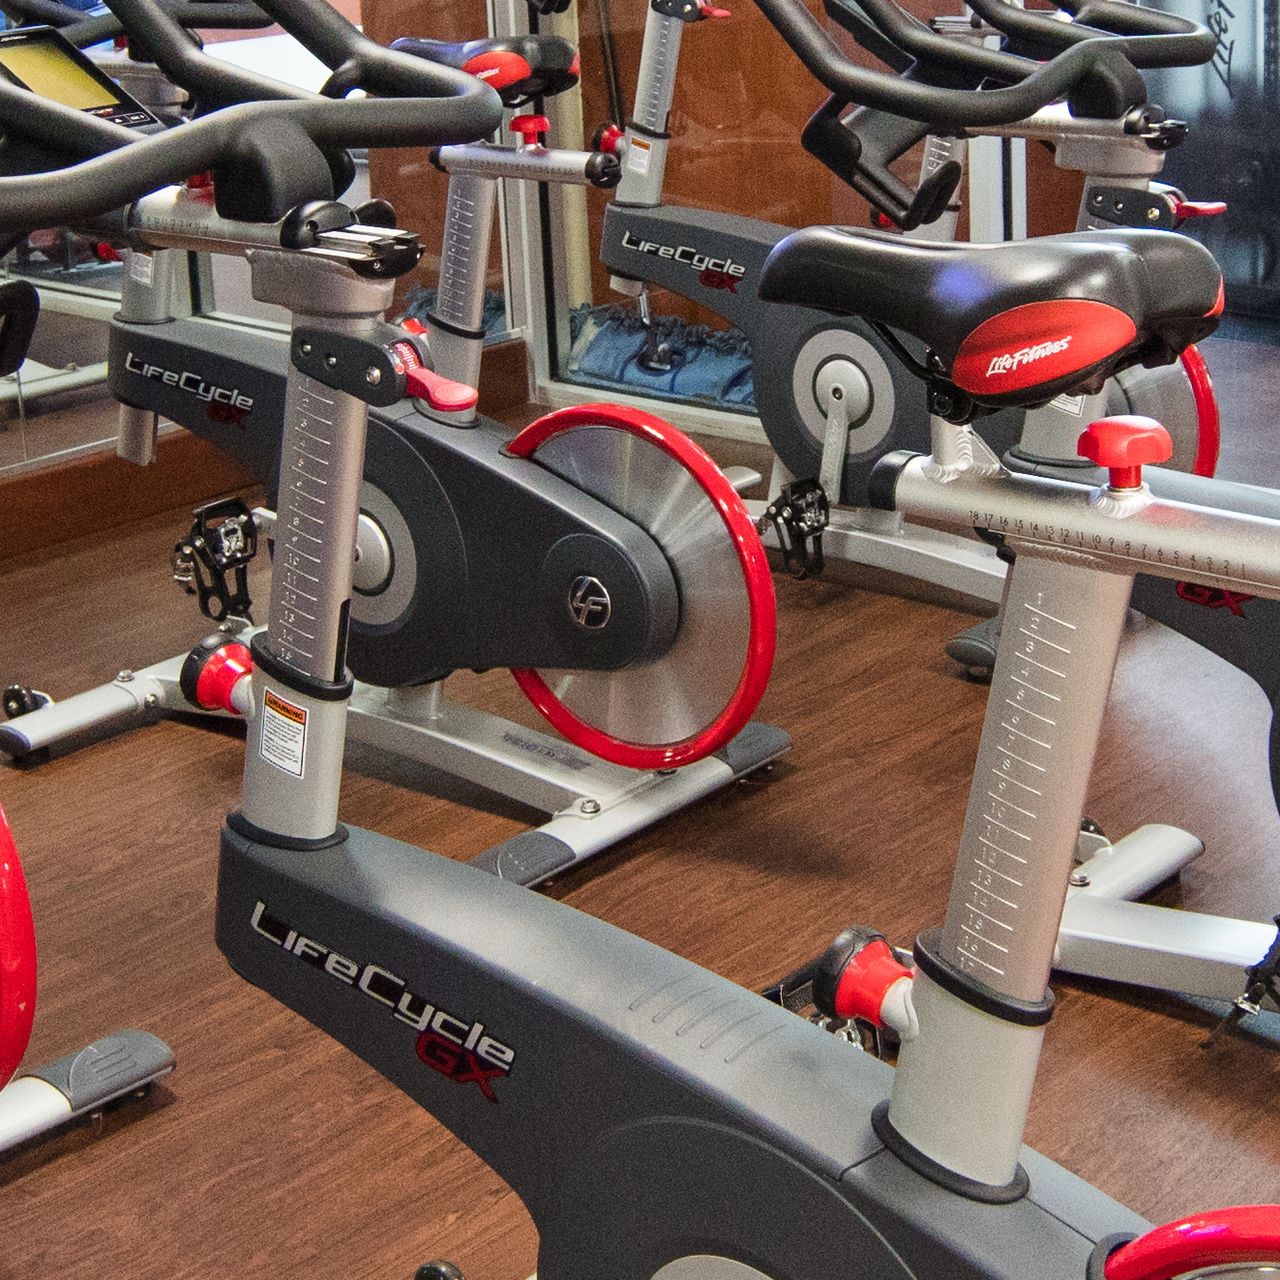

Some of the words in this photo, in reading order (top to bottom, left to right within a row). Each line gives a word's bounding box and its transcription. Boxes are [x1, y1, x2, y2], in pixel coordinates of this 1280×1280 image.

[621, 230, 746, 278] LifeCycle
[125, 351, 255, 412] LifeCycle
[970, 510, 979, 520] 18
[984, 513, 993, 522] 17
[999, 516, 1009, 526] 16
[1014, 519, 1024, 529] 15
[1029, 522, 1039, 532] 14
[1044, 525, 1055, 535] 13
[1060, 528, 1069, 538] 12
[1075, 531, 1084, 541] 11
[1091, 534, 1101, 544] 10
[250, 900, 515, 1071] LifeCycle
[415, 1031, 512, 1104] GX
